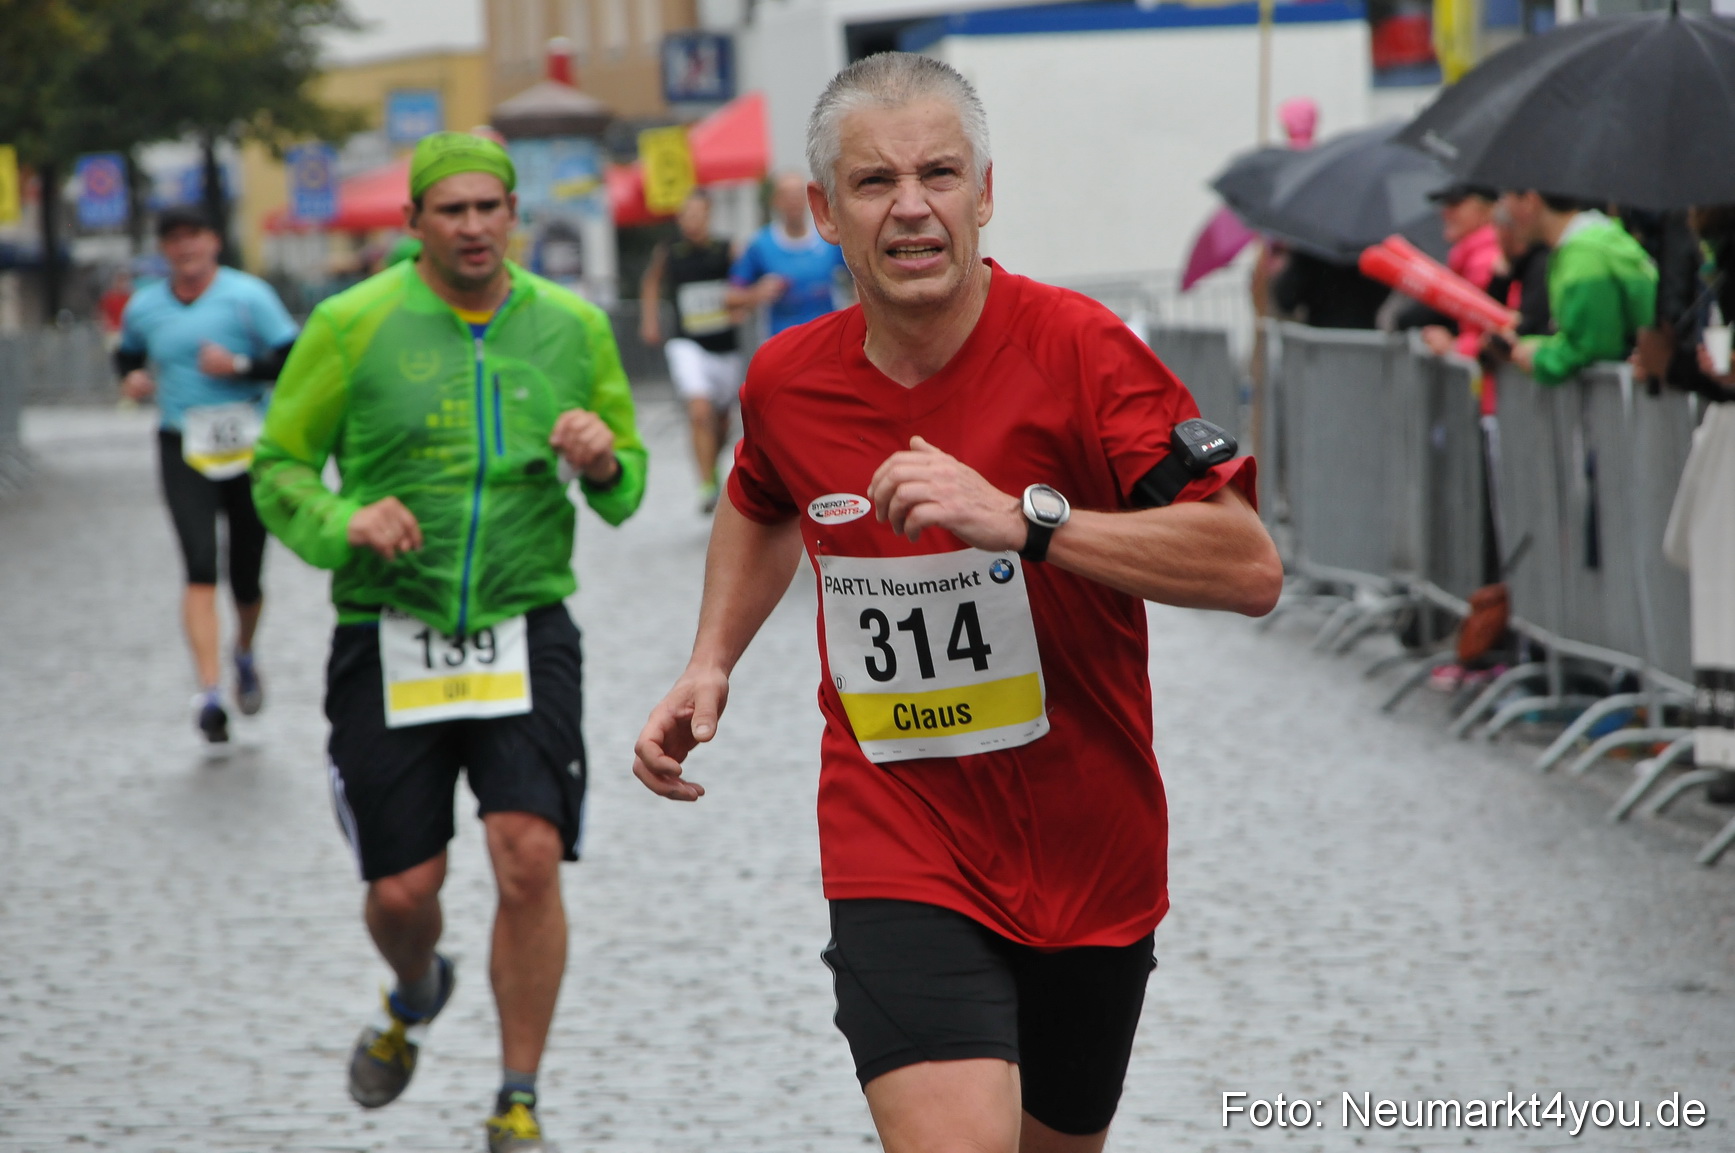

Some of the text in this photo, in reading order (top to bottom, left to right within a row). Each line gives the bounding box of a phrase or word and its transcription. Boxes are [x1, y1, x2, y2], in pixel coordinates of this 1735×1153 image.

[811, 499, 847, 511] SYNERGY
[824, 507, 860, 518] SPORTS
[824, 570, 981, 597] PARTL Neumarkt
[414, 625, 497, 669] 139
[859, 600, 992, 683] 314
[893, 702, 973, 731] Claus
